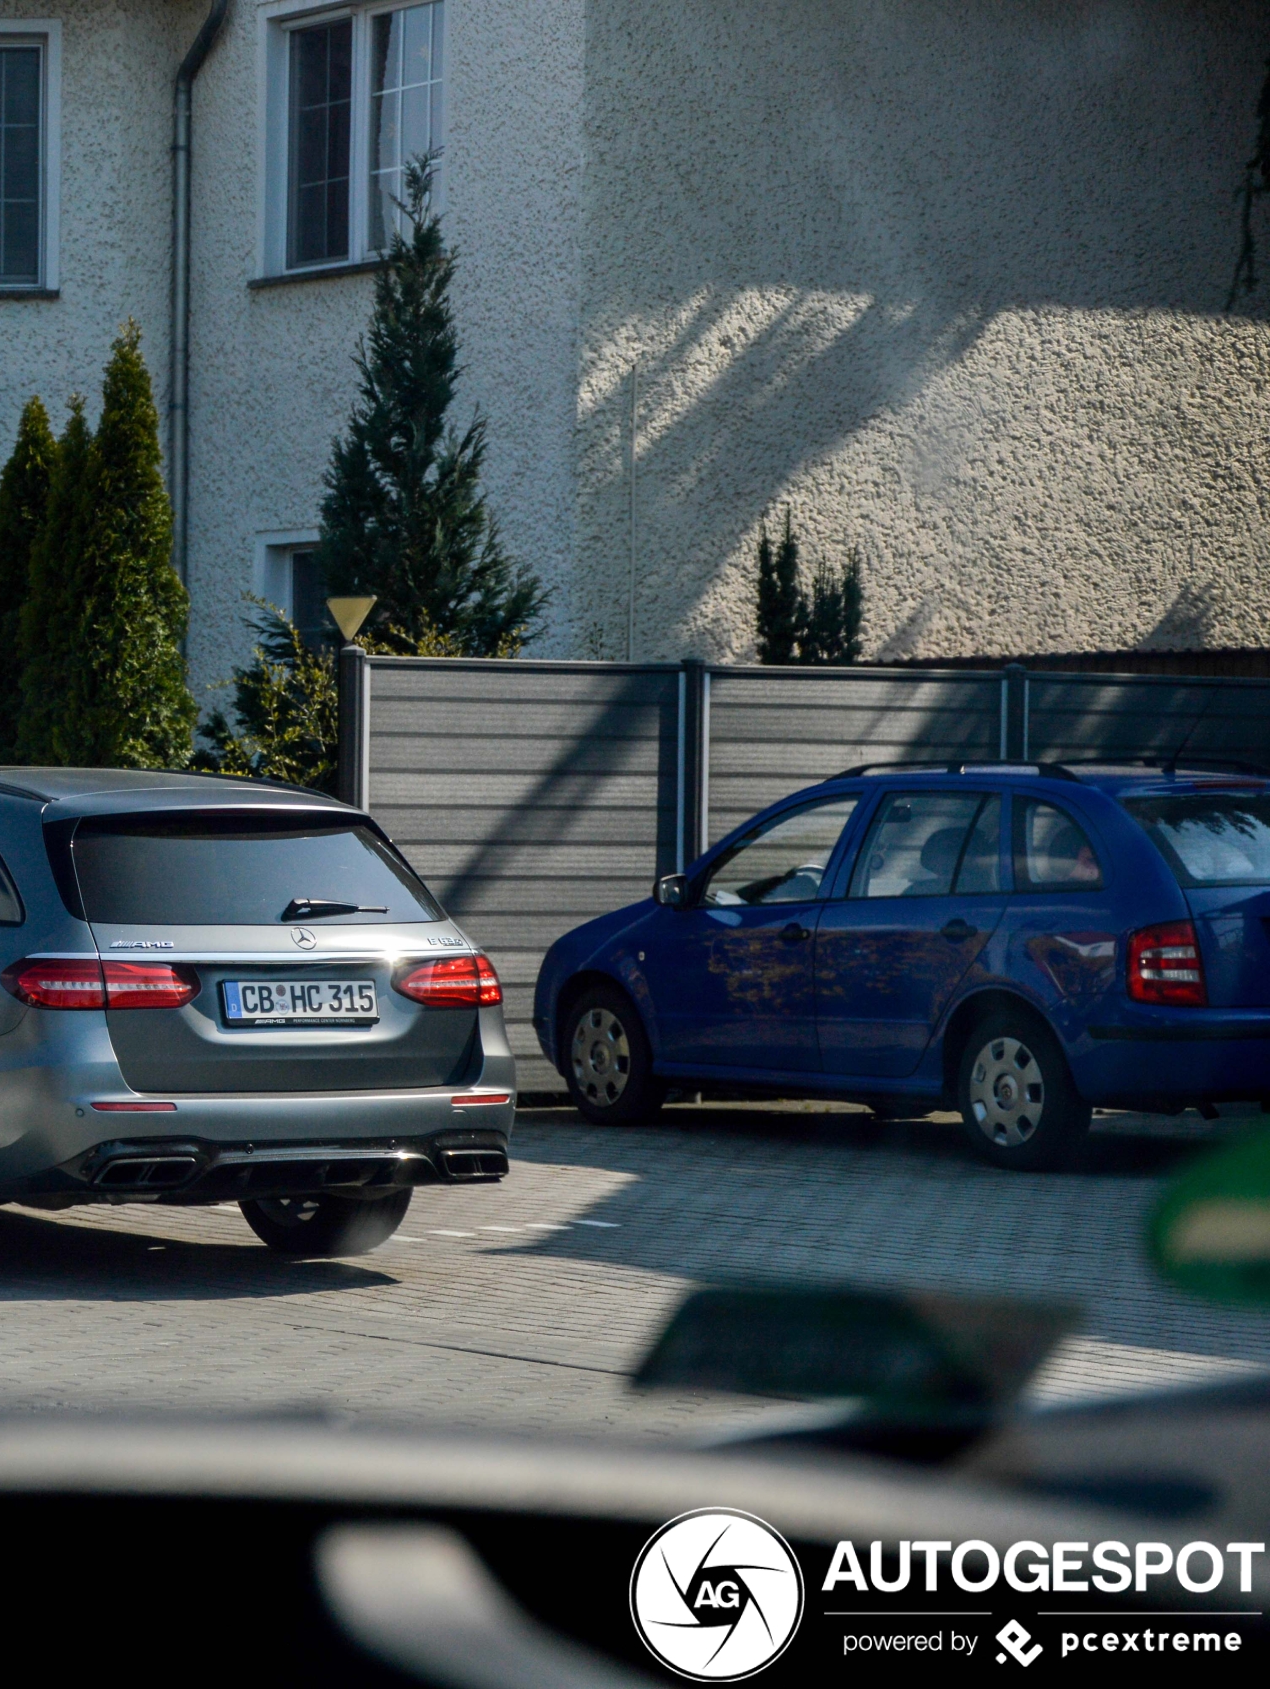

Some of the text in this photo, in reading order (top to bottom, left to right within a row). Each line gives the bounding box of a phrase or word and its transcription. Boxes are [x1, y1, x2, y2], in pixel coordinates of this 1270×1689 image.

[241, 984, 375, 1014] CB HC 315
